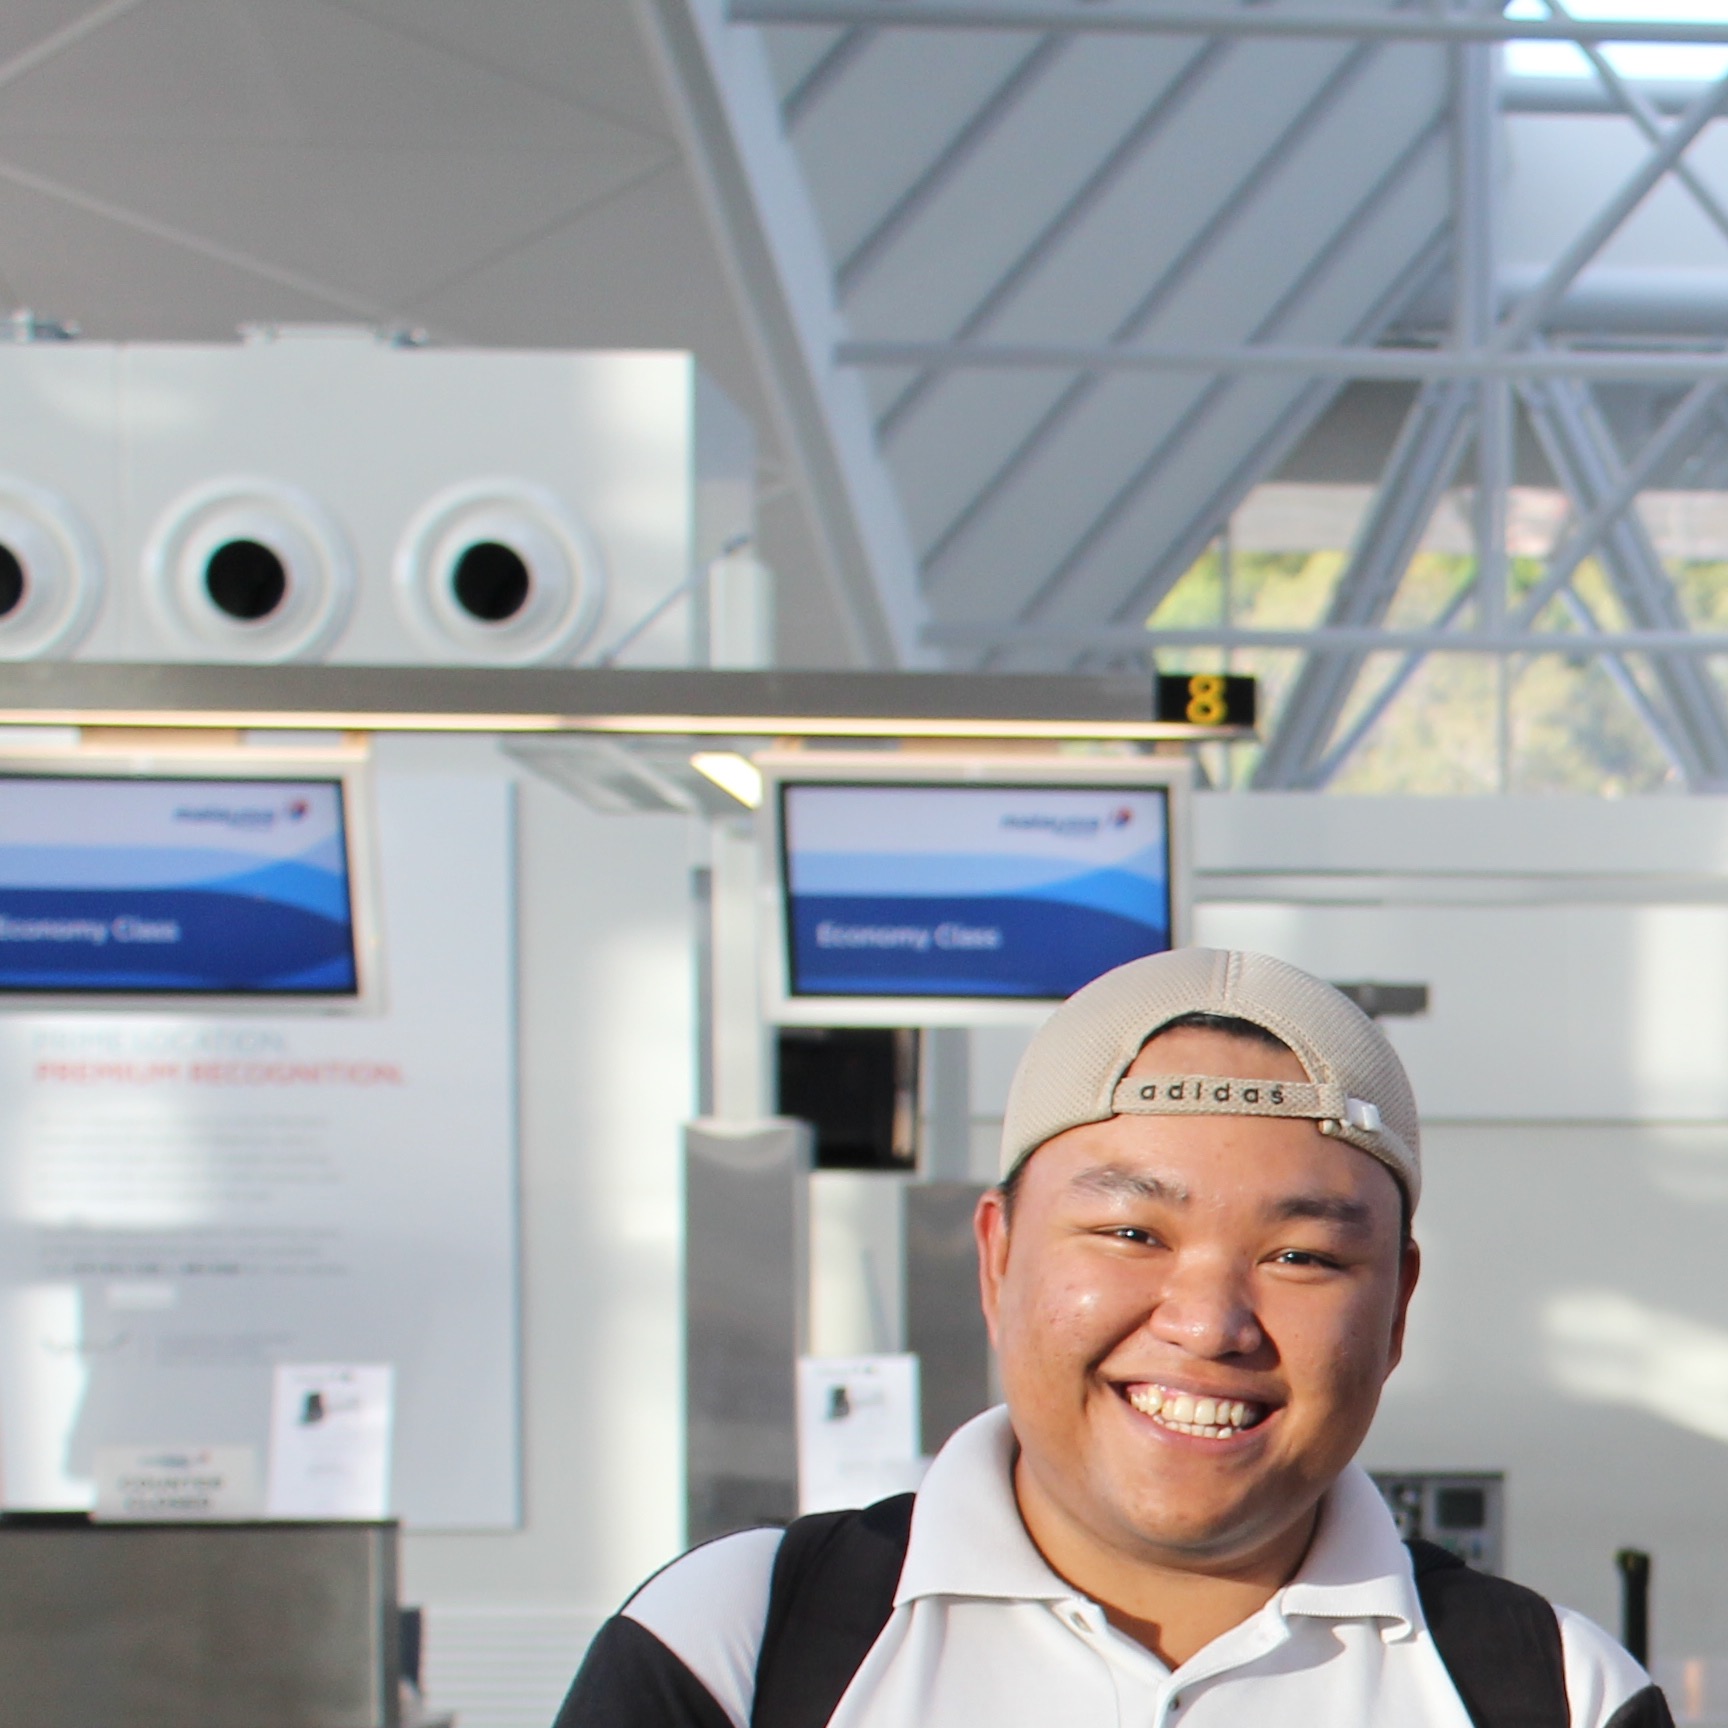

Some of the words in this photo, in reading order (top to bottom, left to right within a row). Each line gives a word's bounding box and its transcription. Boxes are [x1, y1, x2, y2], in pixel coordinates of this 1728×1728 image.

[1187, 675, 1227, 723] 8
[111, 916, 180, 943] Class
[815, 920, 929, 952] Economy
[934, 922, 999, 950] Class
[1140, 1081, 1285, 1105] adidas
